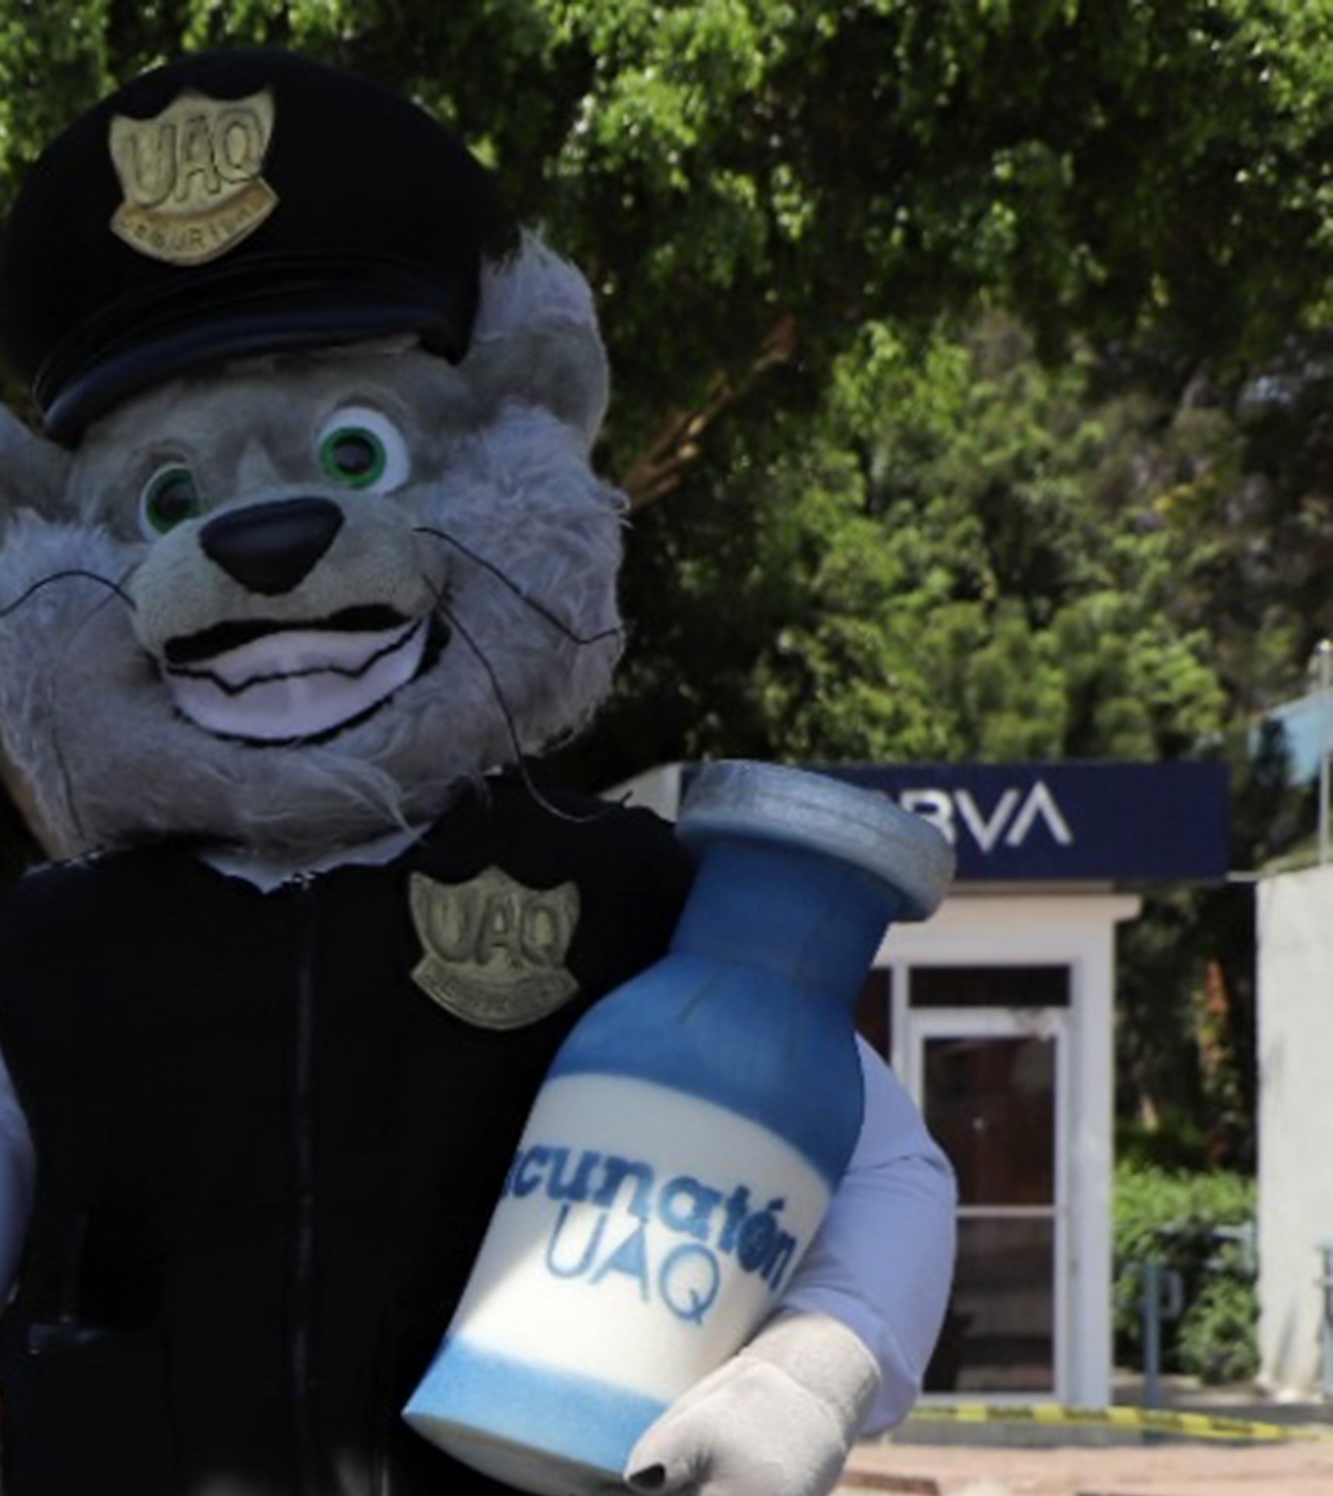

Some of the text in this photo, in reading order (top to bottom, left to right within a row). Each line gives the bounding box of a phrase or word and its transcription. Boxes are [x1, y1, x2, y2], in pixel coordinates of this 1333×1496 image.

[123, 107, 265, 207] UAQ
[899, 780, 1074, 853] BVA
[423, 890, 566, 967] UAQ
[545, 1204, 722, 1327] UAQ
